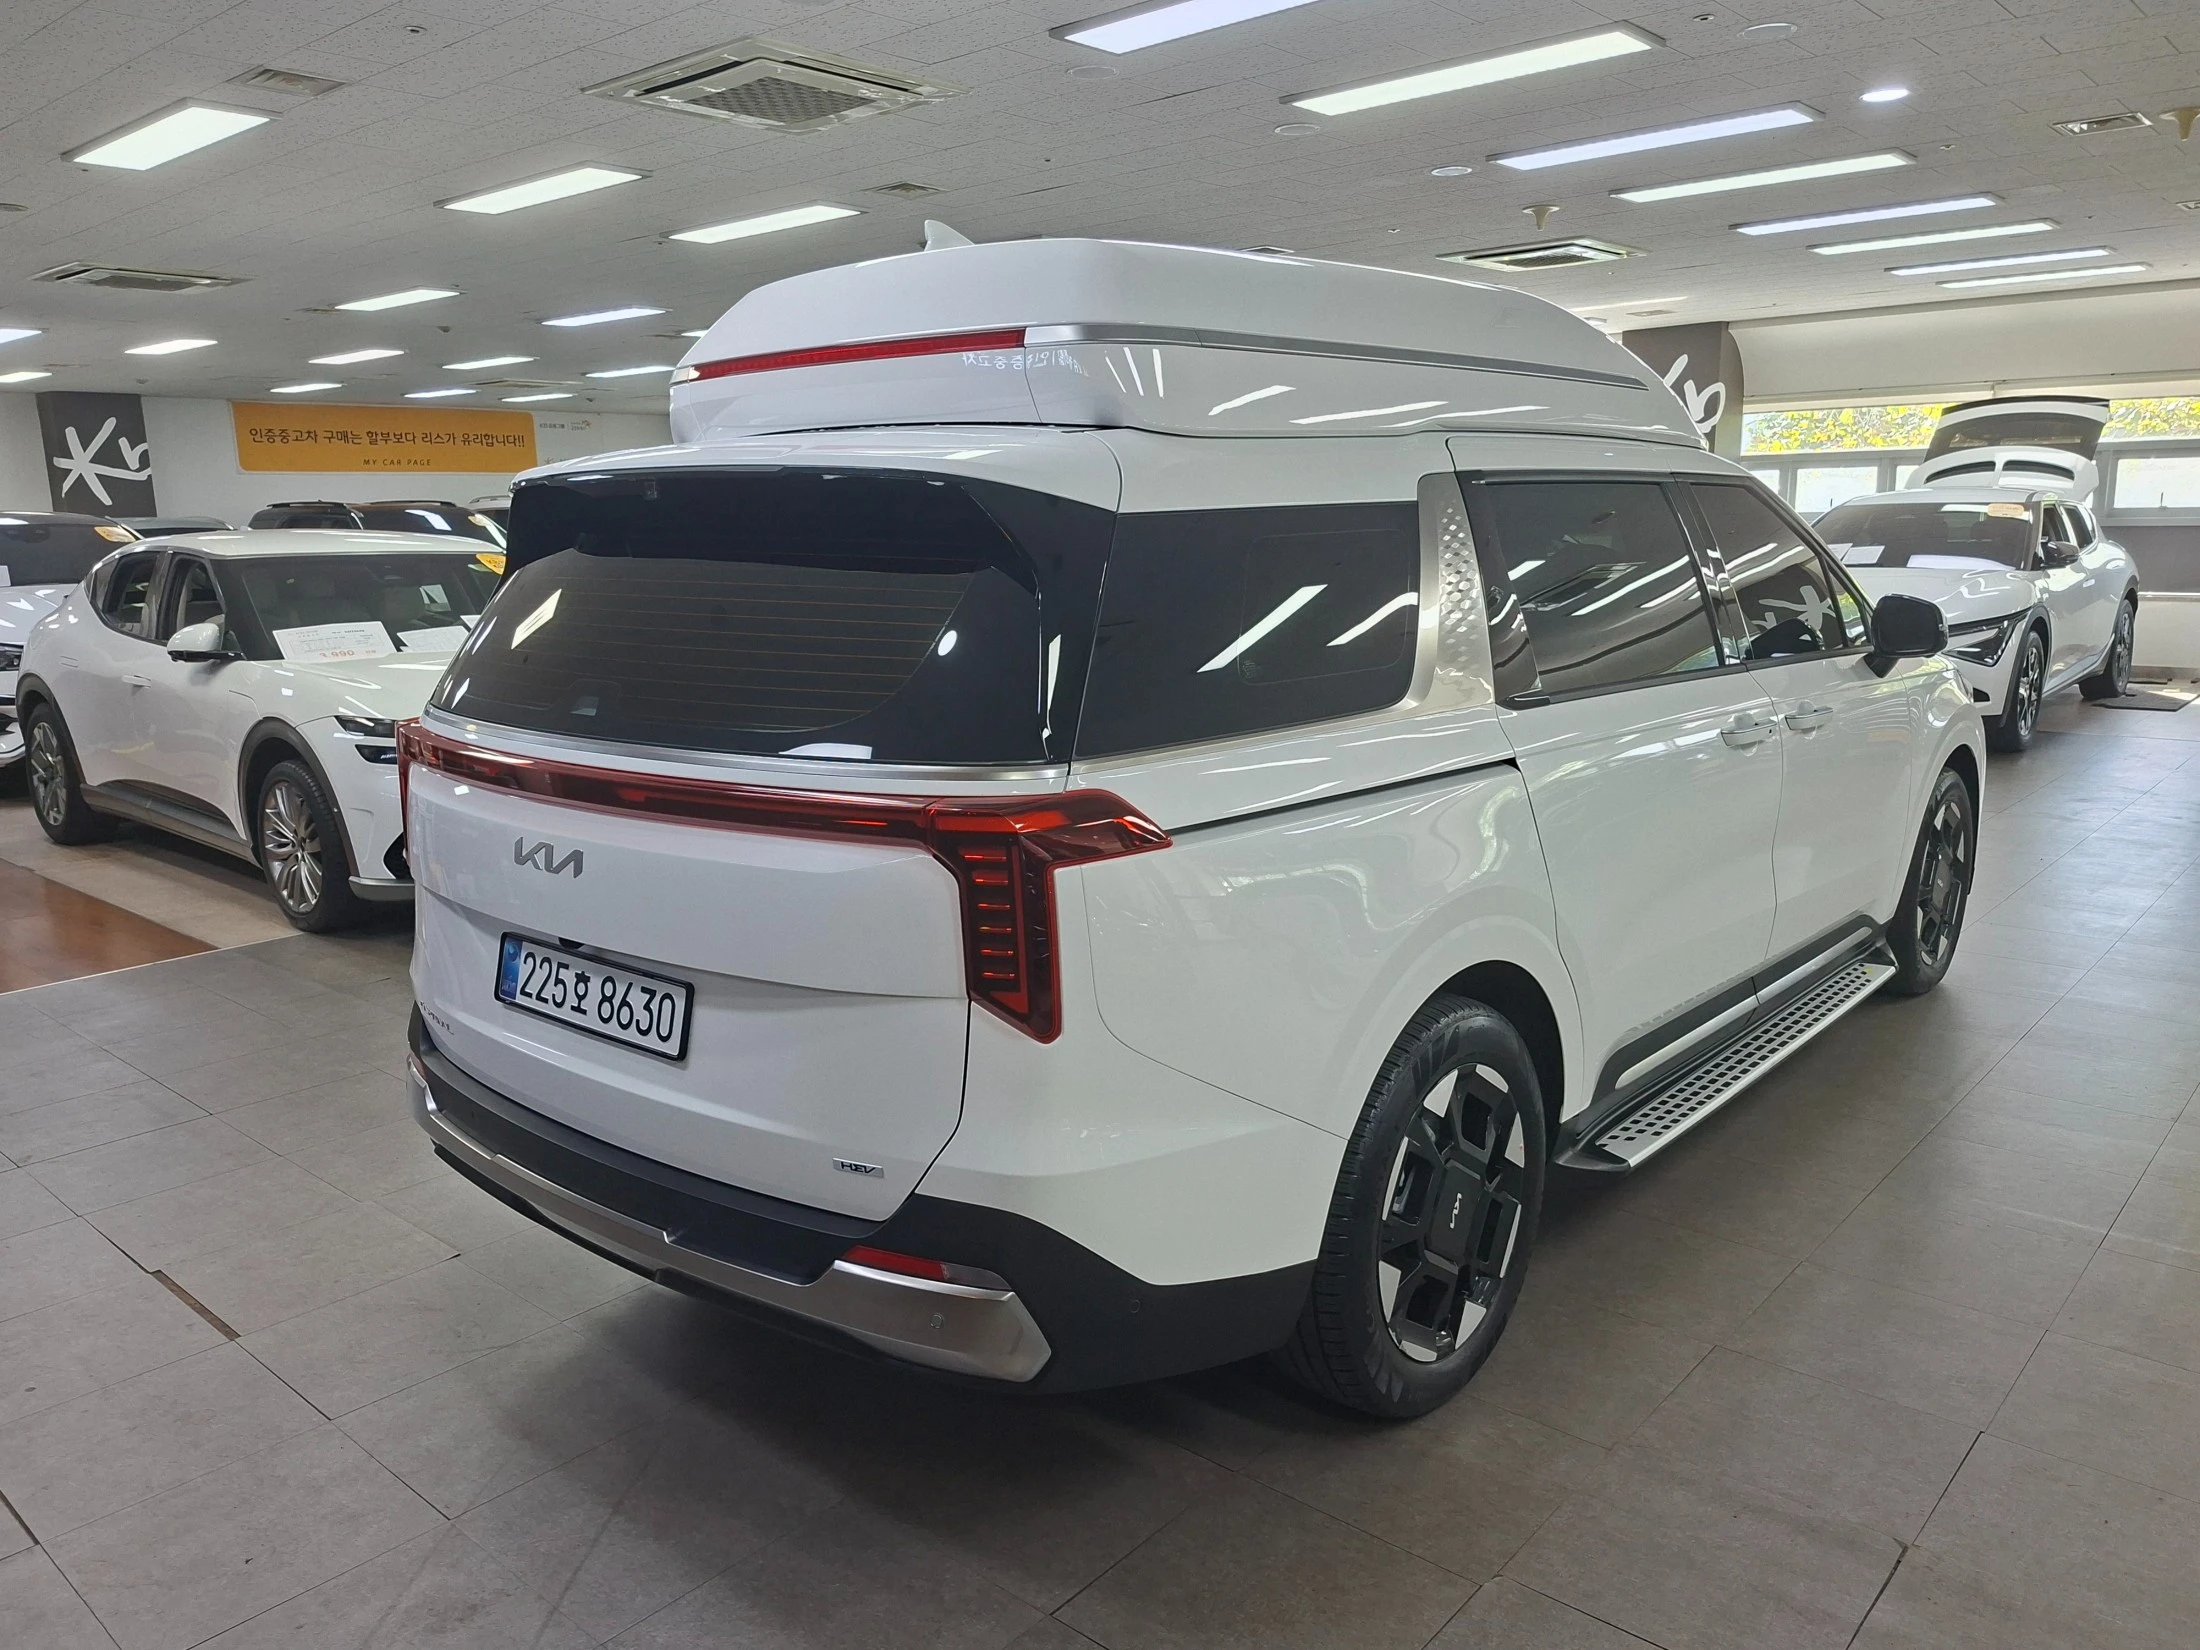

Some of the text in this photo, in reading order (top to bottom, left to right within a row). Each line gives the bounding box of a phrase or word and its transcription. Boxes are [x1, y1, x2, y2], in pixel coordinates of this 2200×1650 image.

[249, 428, 525, 448] 인증중고차 구매는 할부보다 리스가 유리합니다!!
[382, 459, 402, 467] CAR
[407, 459, 431, 467] PAGE
[513, 836, 584, 879] KIA
[519, 951, 677, 1043] 225호 8630
[840, 1161, 877, 1174] HEV
